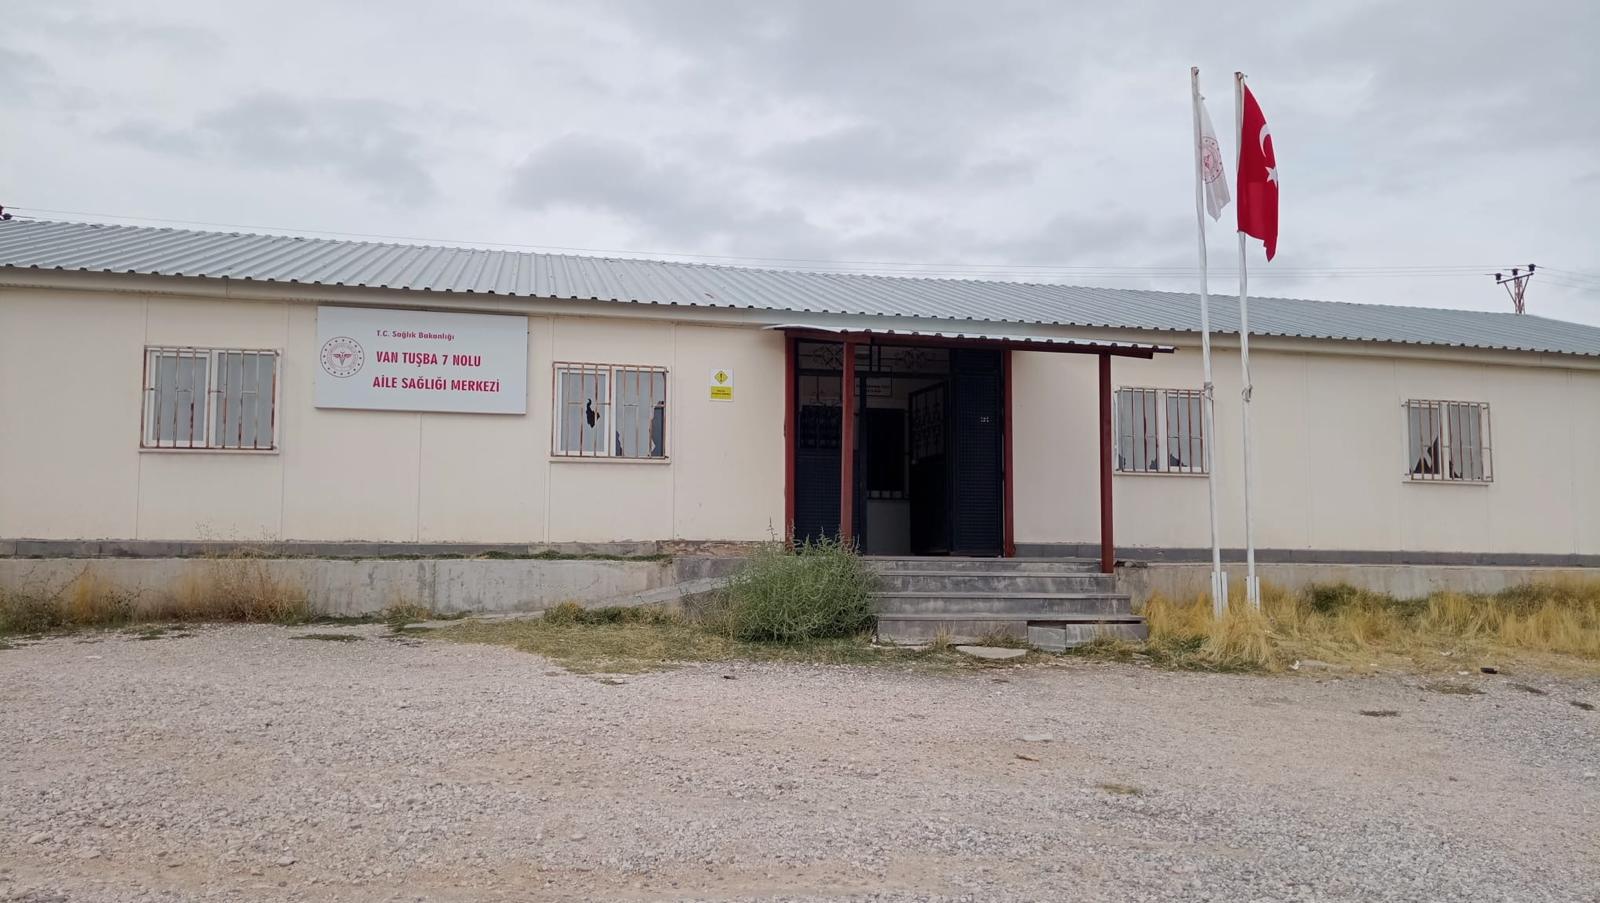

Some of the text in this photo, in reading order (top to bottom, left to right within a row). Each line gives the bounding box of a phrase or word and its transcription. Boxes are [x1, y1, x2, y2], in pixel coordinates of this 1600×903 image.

[392, 330, 416, 339] Sağlık
[418, 332, 455, 341] Bakanlığı
[376, 351, 481, 367] VAN TUŞBA 7 NOLU
[372, 374, 500, 392] AİLE SAĞLIĞI MERKEZİ
